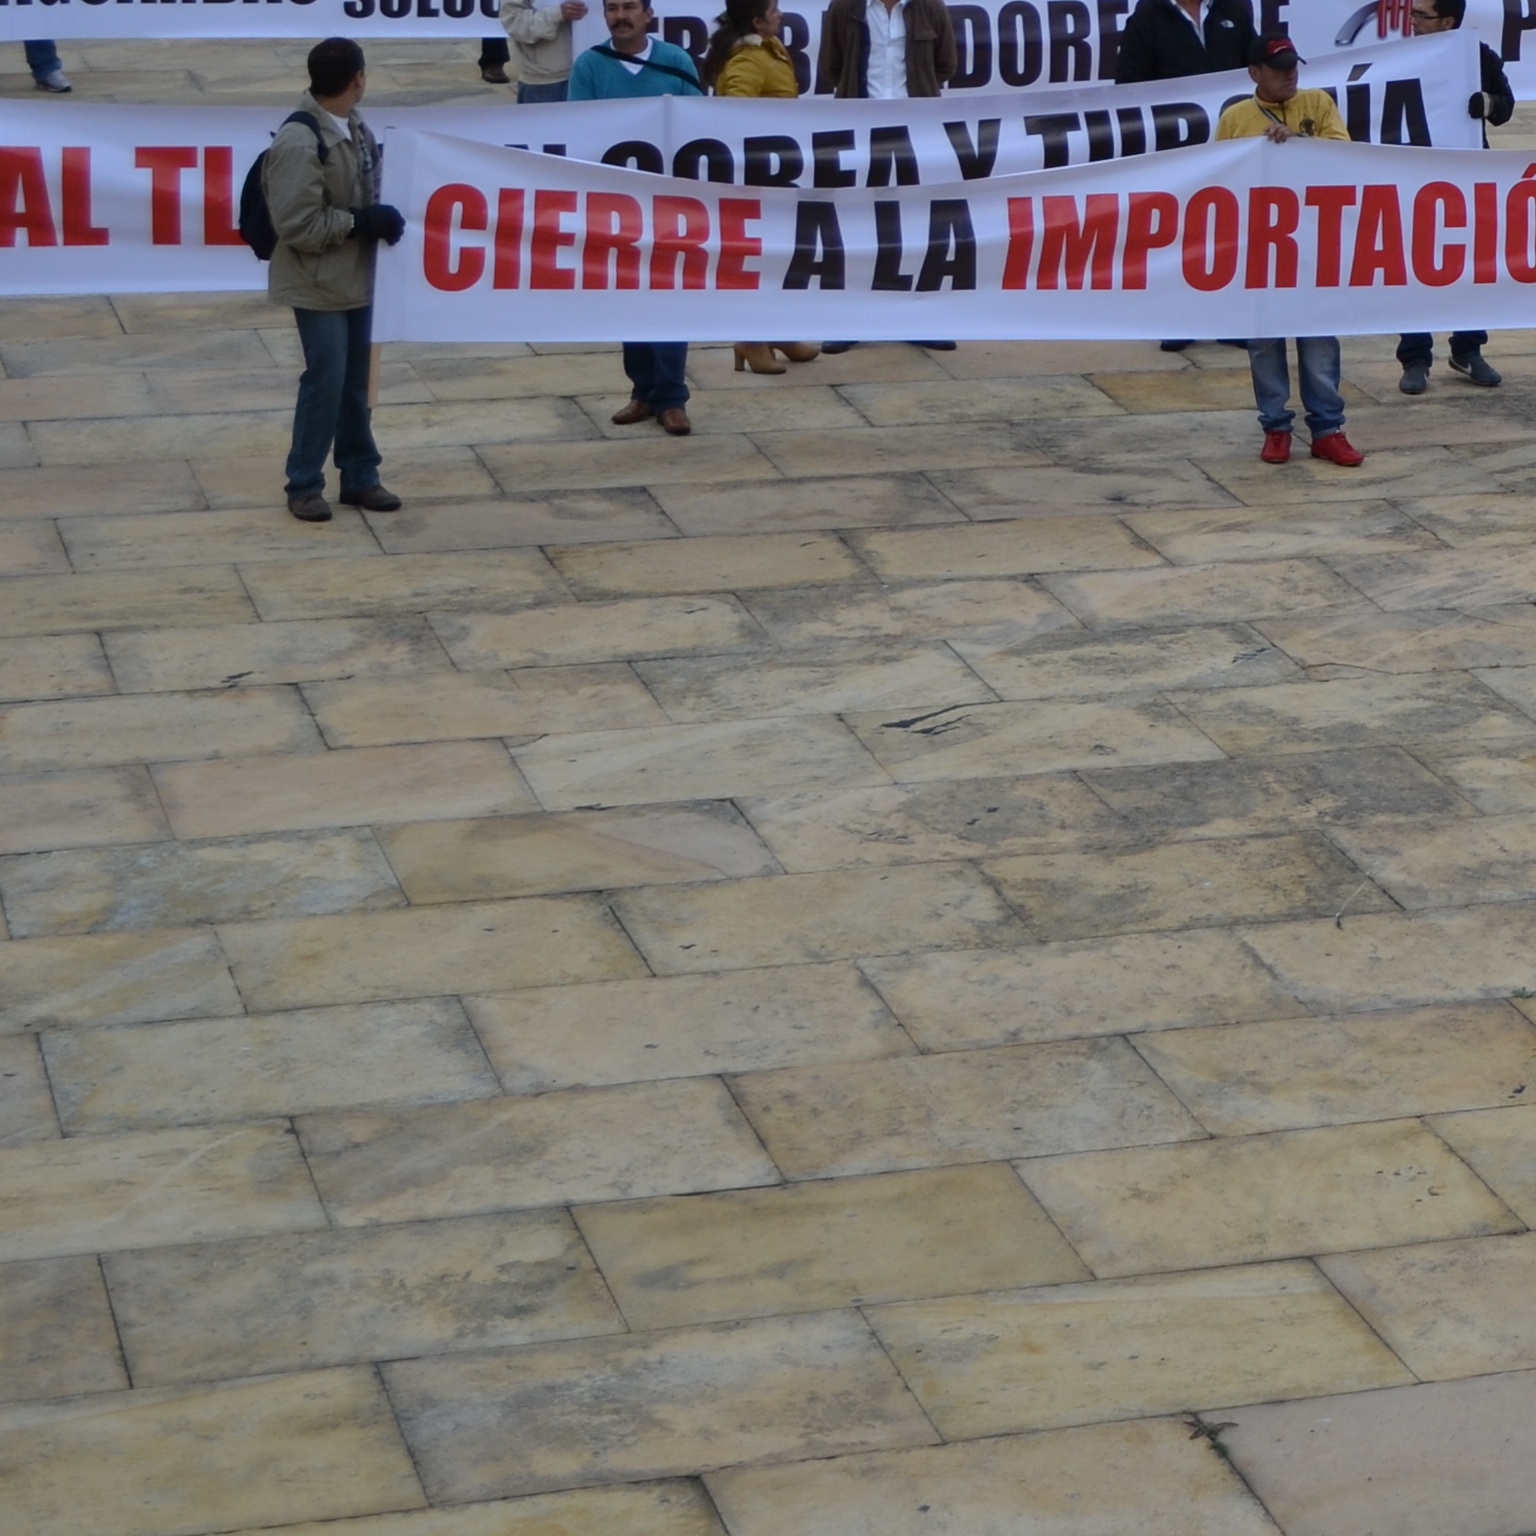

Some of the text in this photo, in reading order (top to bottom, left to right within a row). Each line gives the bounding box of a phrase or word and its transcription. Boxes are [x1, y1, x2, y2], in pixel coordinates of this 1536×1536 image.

[0, 146, 250, 247] AL TL
[424, 183, 762, 293] CIERRE
[782, 201, 845, 292] A
[873, 199, 976, 292] LA
